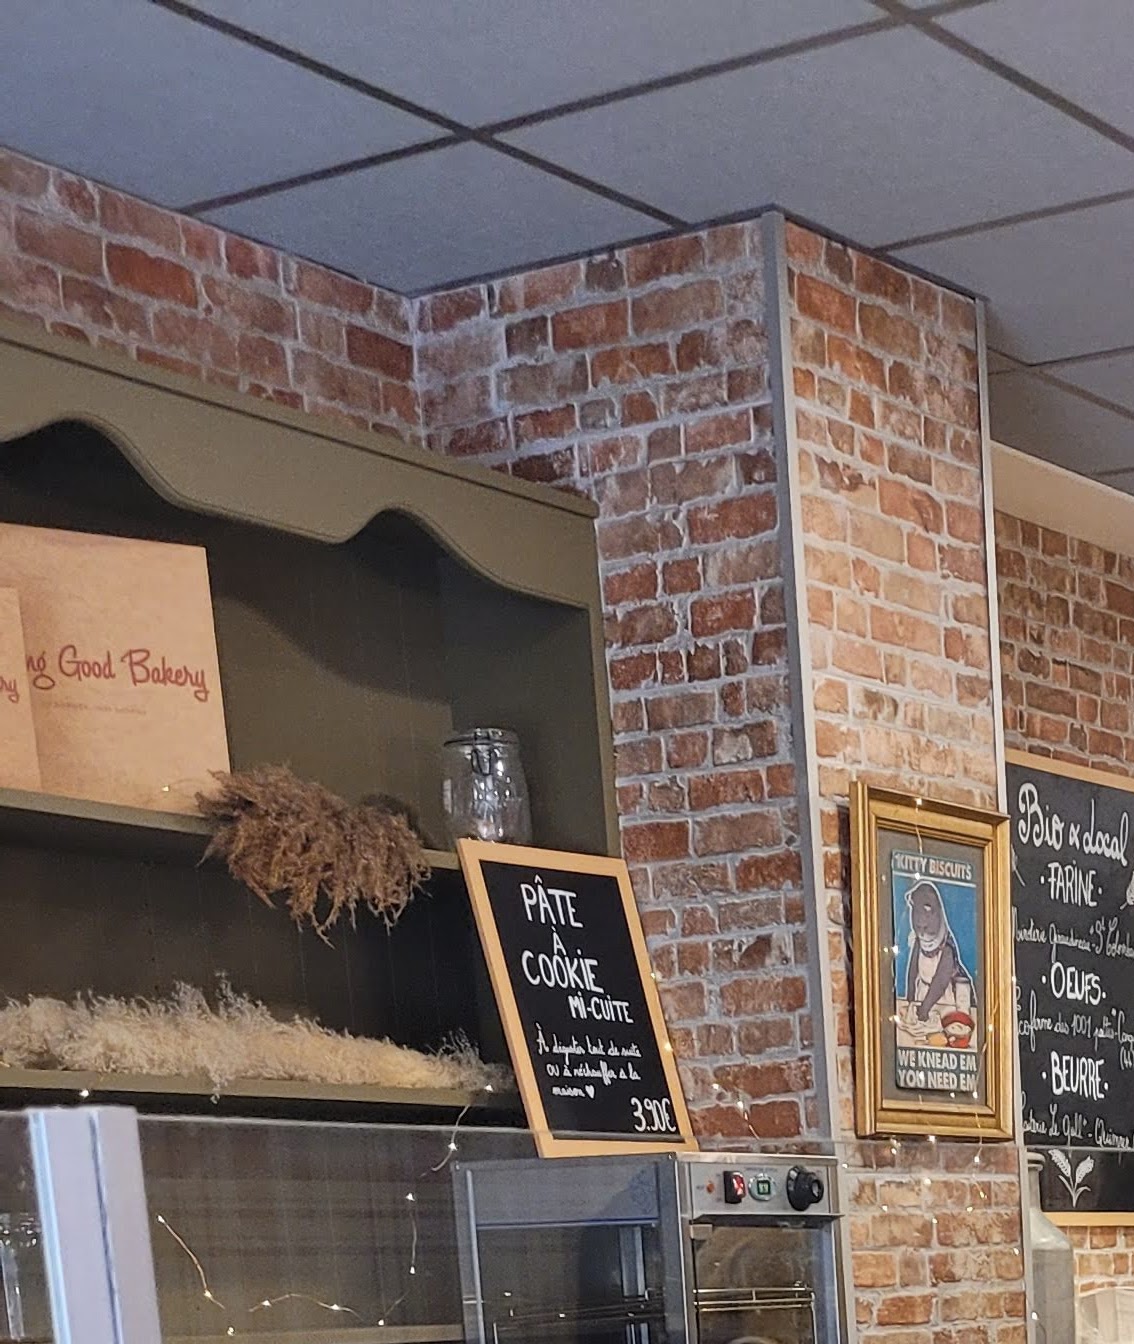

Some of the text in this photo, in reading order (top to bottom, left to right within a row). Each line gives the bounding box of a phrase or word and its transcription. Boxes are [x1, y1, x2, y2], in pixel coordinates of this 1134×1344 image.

[58, 644, 116, 682] Good
[120, 648, 210, 702] Bakery
[1018, 782, 1065, 851] Bio
[929, 858, 973, 880] BISCUITS
[1047, 860, 1097, 907] FARINE
[520, 874, 583, 928] PÂTE
[551, 925, 567, 956] À
[521, 949, 604, 994] COOKIE
[1050, 962, 1101, 1005] OEUFS
[568, 991, 634, 1023] MI-CUITE
[897, 1049, 977, 1072] WE KNEAD EM
[898, 1069, 926, 1089] YOU
[927, 1071, 958, 1090] NEED
[1050, 1050, 1105, 1101] BEURRE
